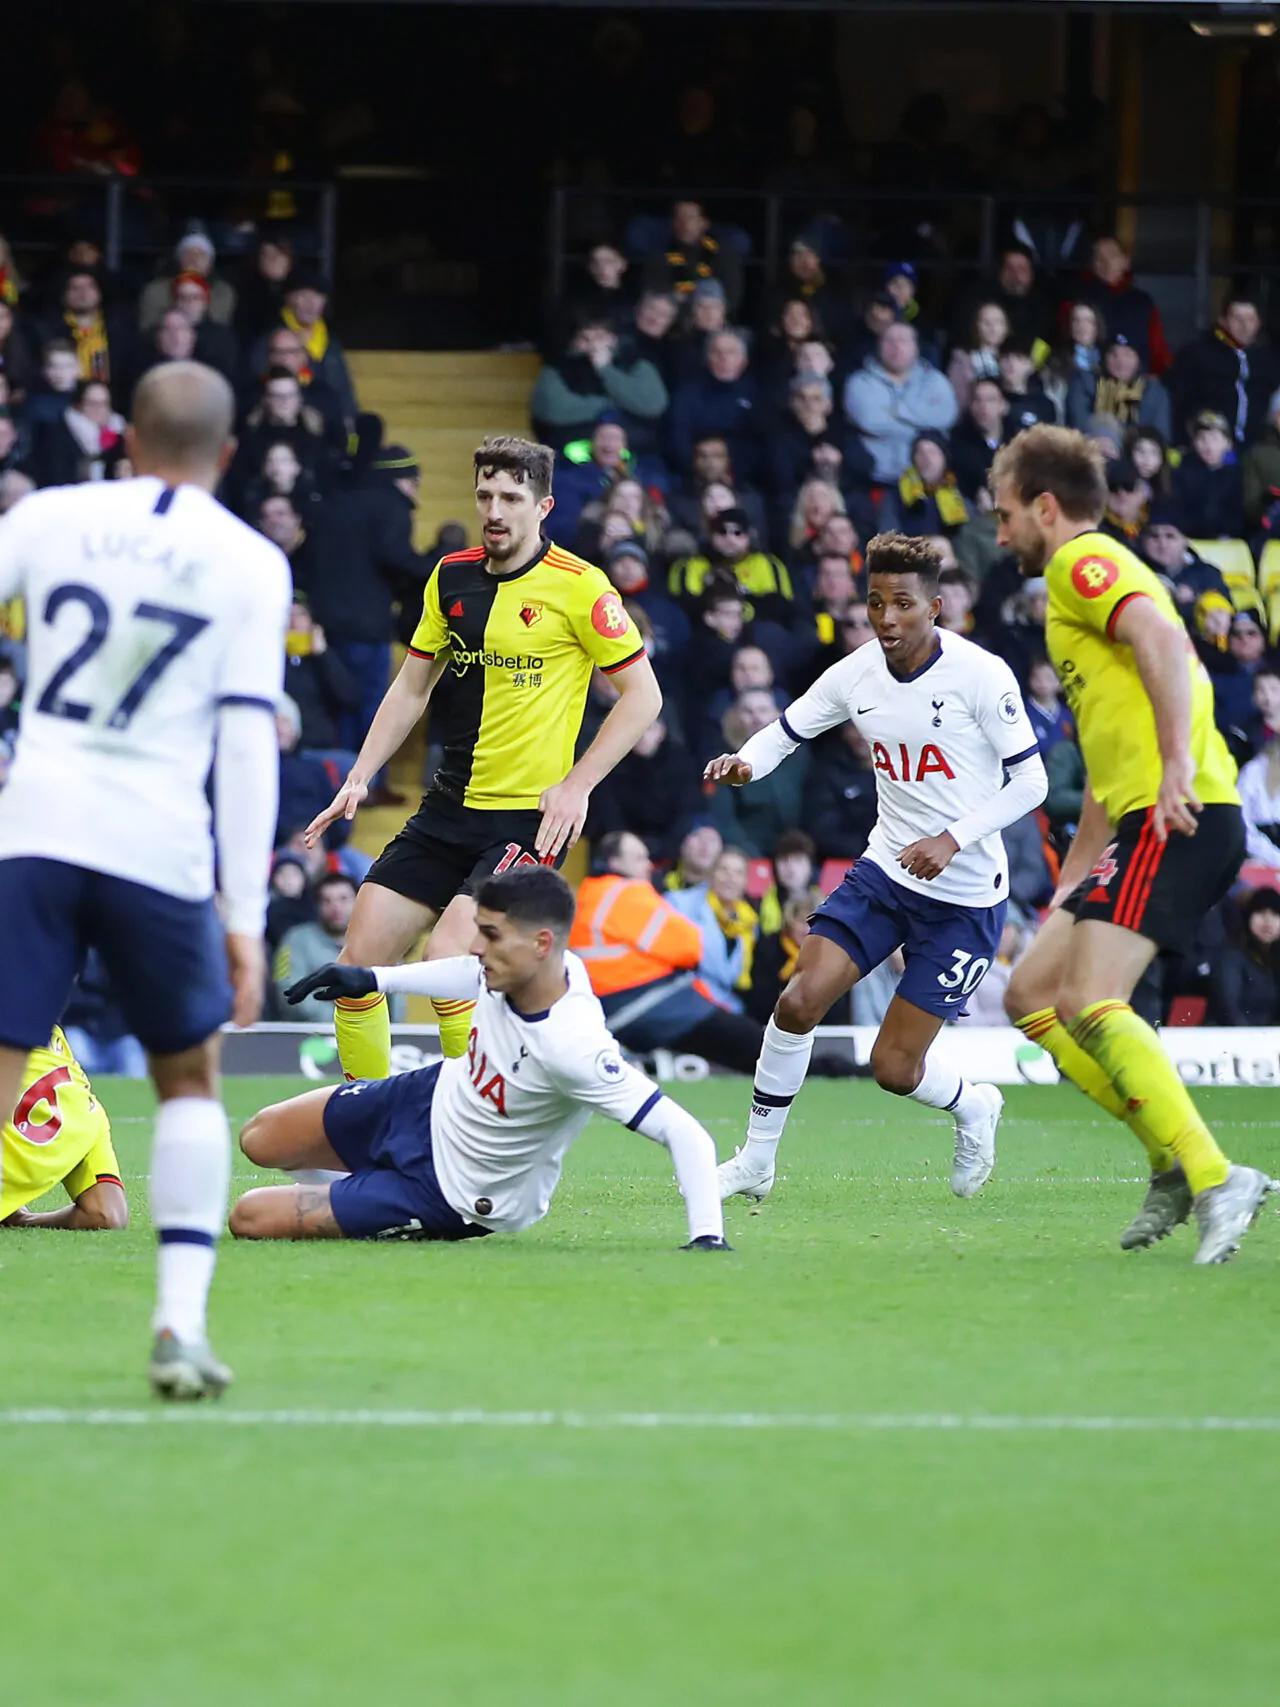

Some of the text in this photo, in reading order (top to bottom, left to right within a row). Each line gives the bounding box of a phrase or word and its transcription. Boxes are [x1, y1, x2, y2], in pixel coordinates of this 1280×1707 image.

[36, 583, 211, 730] 27
[451, 649, 544, 671] portsbet.io
[872, 741, 957, 782] AIA
[937, 948, 990, 995] 30
[468, 1027, 509, 1118] AIA
